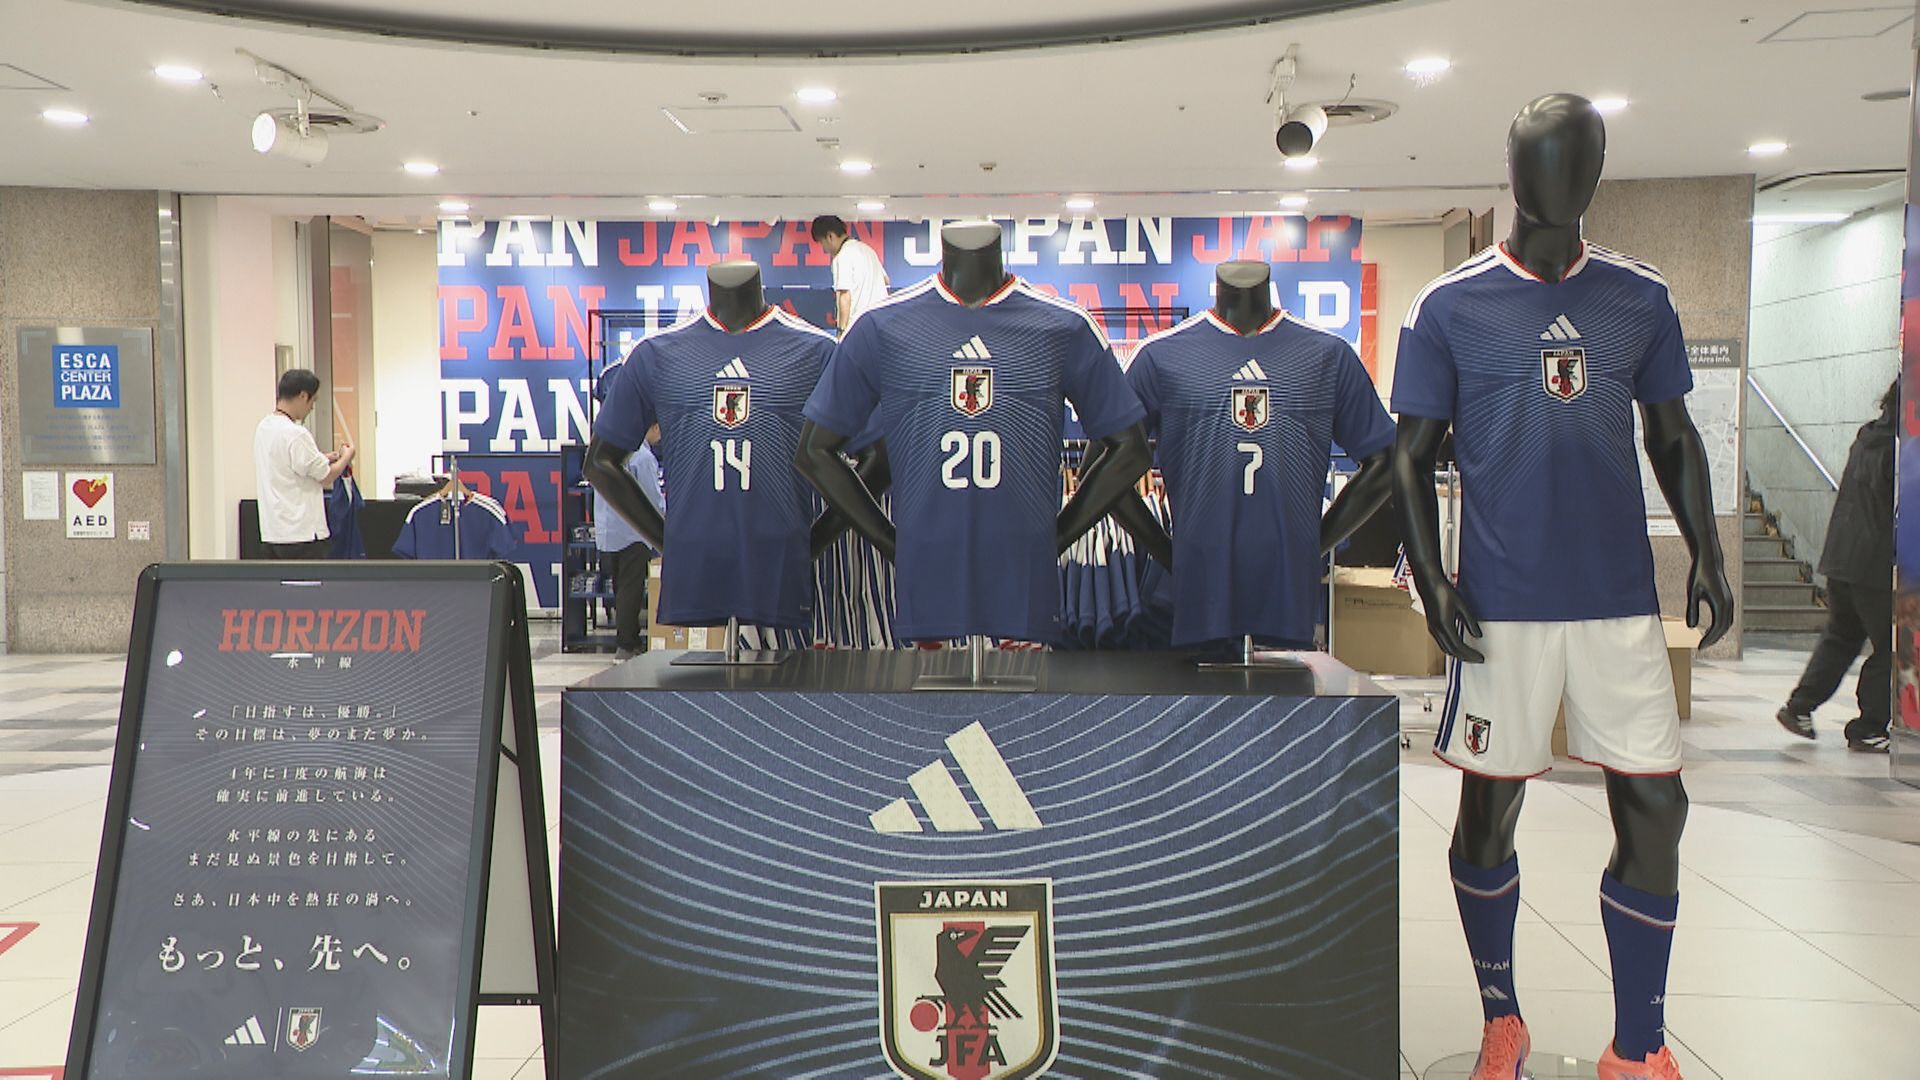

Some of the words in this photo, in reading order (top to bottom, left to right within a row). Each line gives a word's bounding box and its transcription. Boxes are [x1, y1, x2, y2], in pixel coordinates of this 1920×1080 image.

[904, 215, 1172, 266] JPAN
[1192, 214, 1363, 262] JAP
[438, 285, 606, 360] PAN
[60, 353, 111, 368] ESCA
[60, 371, 112, 382] CENTER
[61, 384, 112, 400] PLAZA
[710, 439, 752, 491] 14
[941, 430, 1001, 489] 20
[1237, 442, 1263, 495] 7
[73, 515, 107, 526] AED
[218, 609, 427, 652] HORIZON
[226, 828, 376, 842] 水平線の先にある
[189, 851, 407, 866] まだ見ぬ景色を目指して。
[919, 890, 1009, 909] JAPAN
[158, 934, 411, 972] もっと、先へ。
[929, 1034, 1008, 1067] JFA
